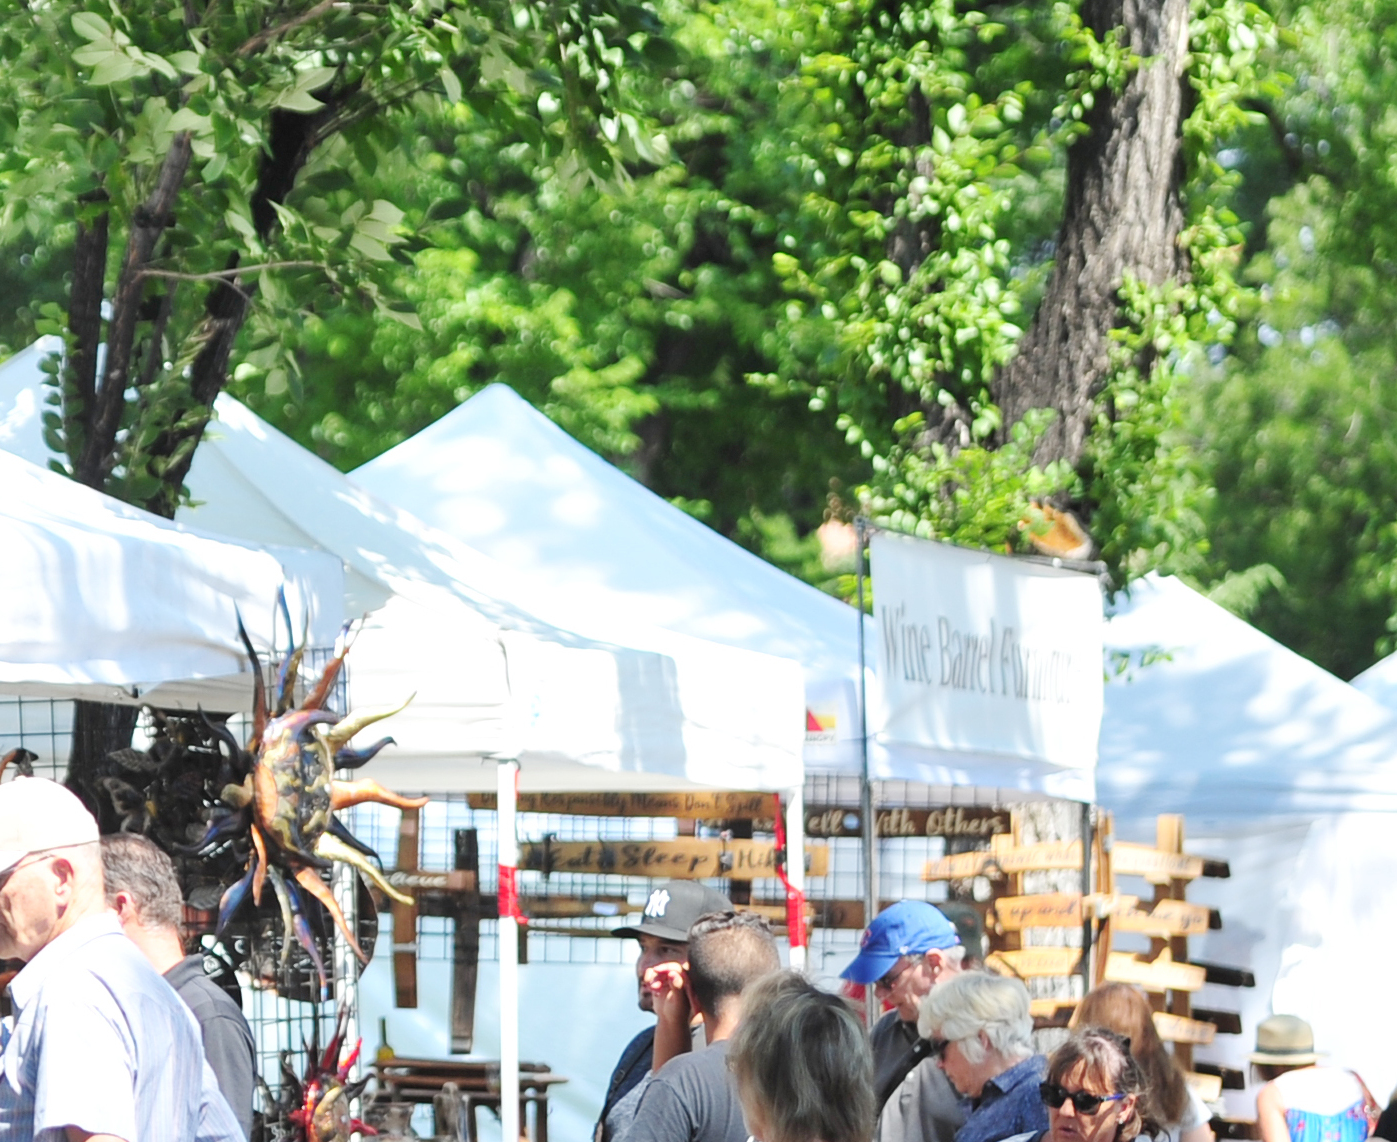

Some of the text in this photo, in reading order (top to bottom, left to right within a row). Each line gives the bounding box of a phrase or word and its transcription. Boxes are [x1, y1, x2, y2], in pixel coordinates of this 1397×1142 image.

[880, 600, 1081, 704] Wine Barrel Furnitur
[804, 808, 845, 836] ell
[925, 807, 1005, 836] Others
[622, 843, 709, 872] Sleep
